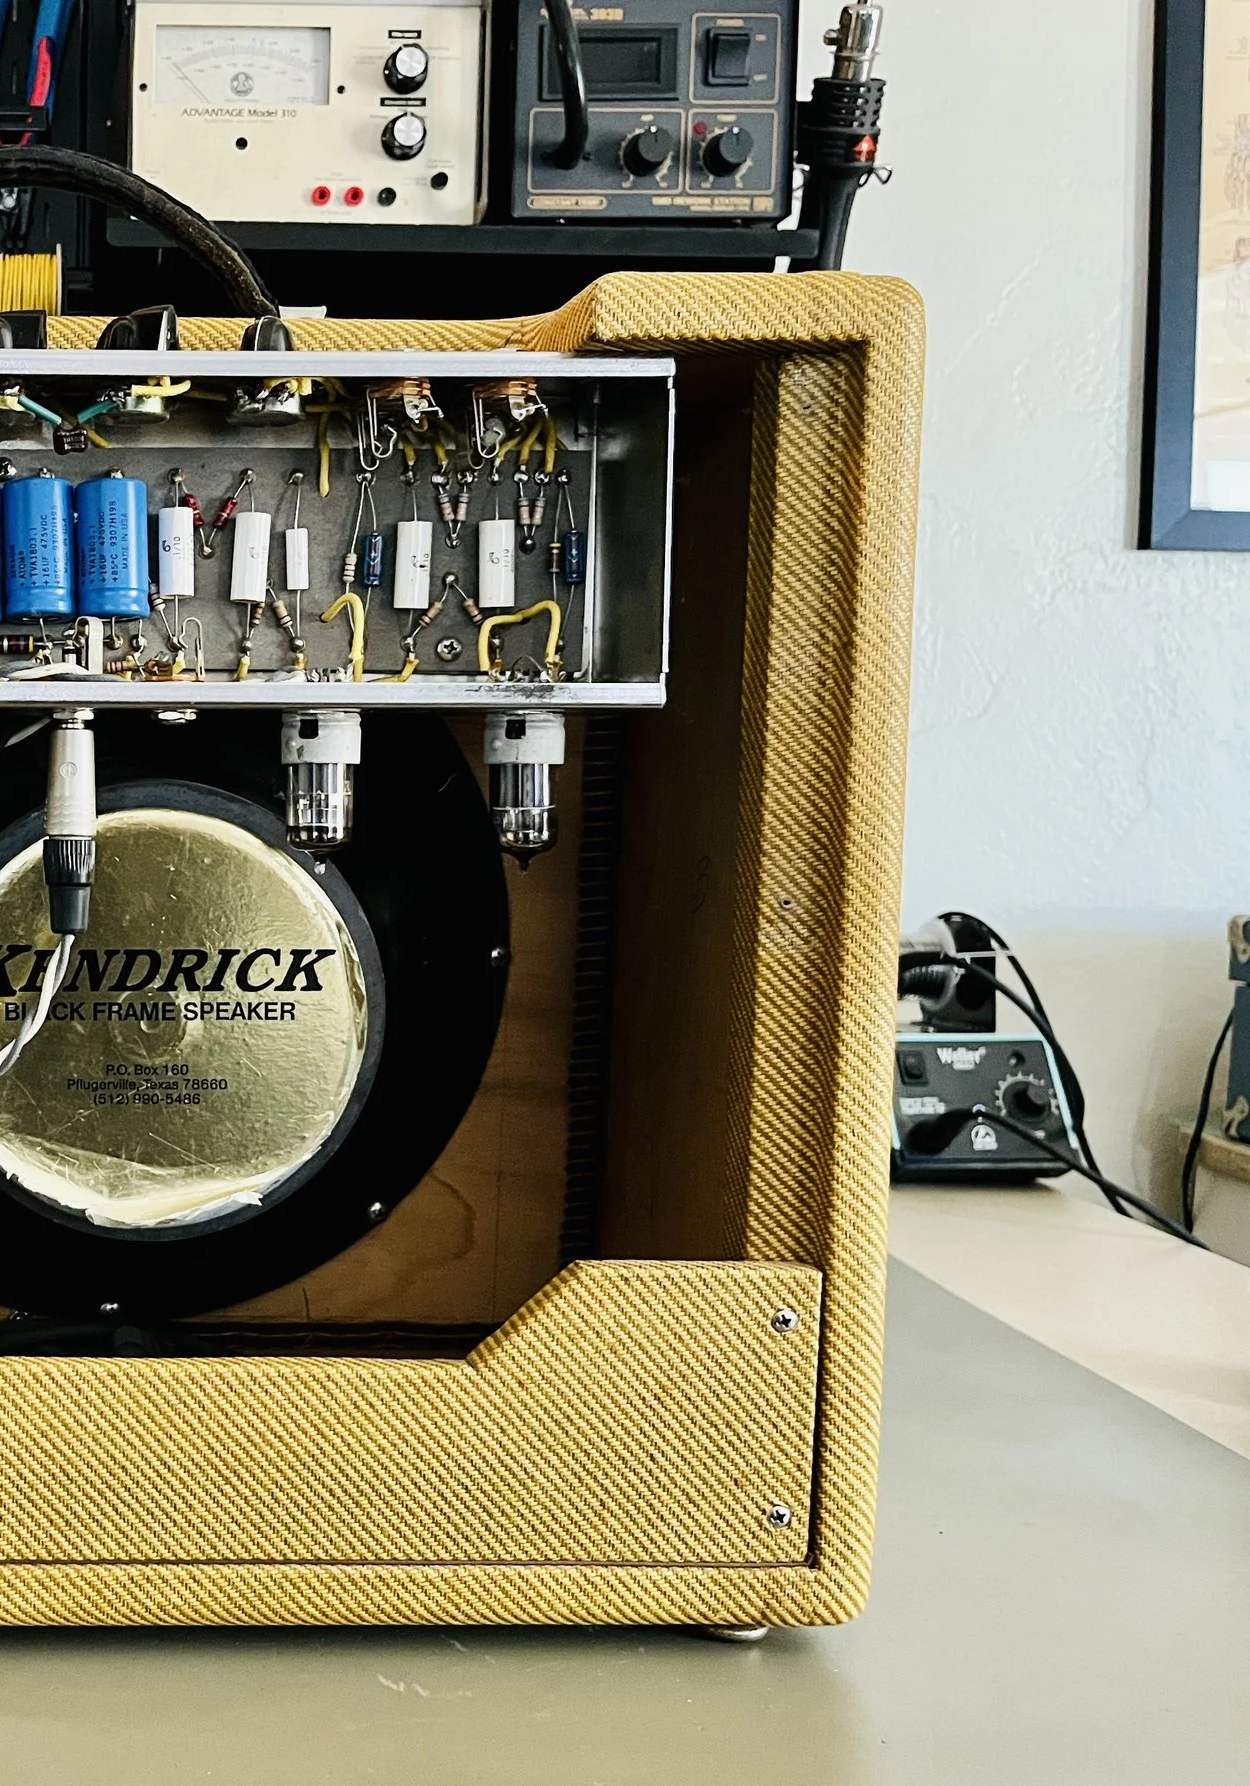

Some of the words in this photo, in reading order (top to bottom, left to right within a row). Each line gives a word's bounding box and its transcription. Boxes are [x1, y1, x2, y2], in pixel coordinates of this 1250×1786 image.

[181, 108, 245, 117] ADVANTAGE
[247, 108, 278, 117] Model
[281, 108, 297, 117] 310
[40, 514, 48, 549] 475VDC
[98, 511, 106, 546] 475VDC
[29, 527, 38, 577] TVA1803.1
[4, 1002, 85, 1021] BLCK
[93, 1002, 176, 1021] FRAME
[183, 1001, 296, 1021] SPEAKER
[106, 1064, 131, 1075] P.O.
[135, 1064, 159, 1075] Box
[164, 1064, 189, 1076] 160
[67, 1079, 140, 1092] Pflugerville,
[145, 1079, 179, 1090] Texas
[183, 1078, 228, 1090] 78660
[93, 1093, 128, 1105] (512)
[132, 1093, 201, 1105] 990-5486
